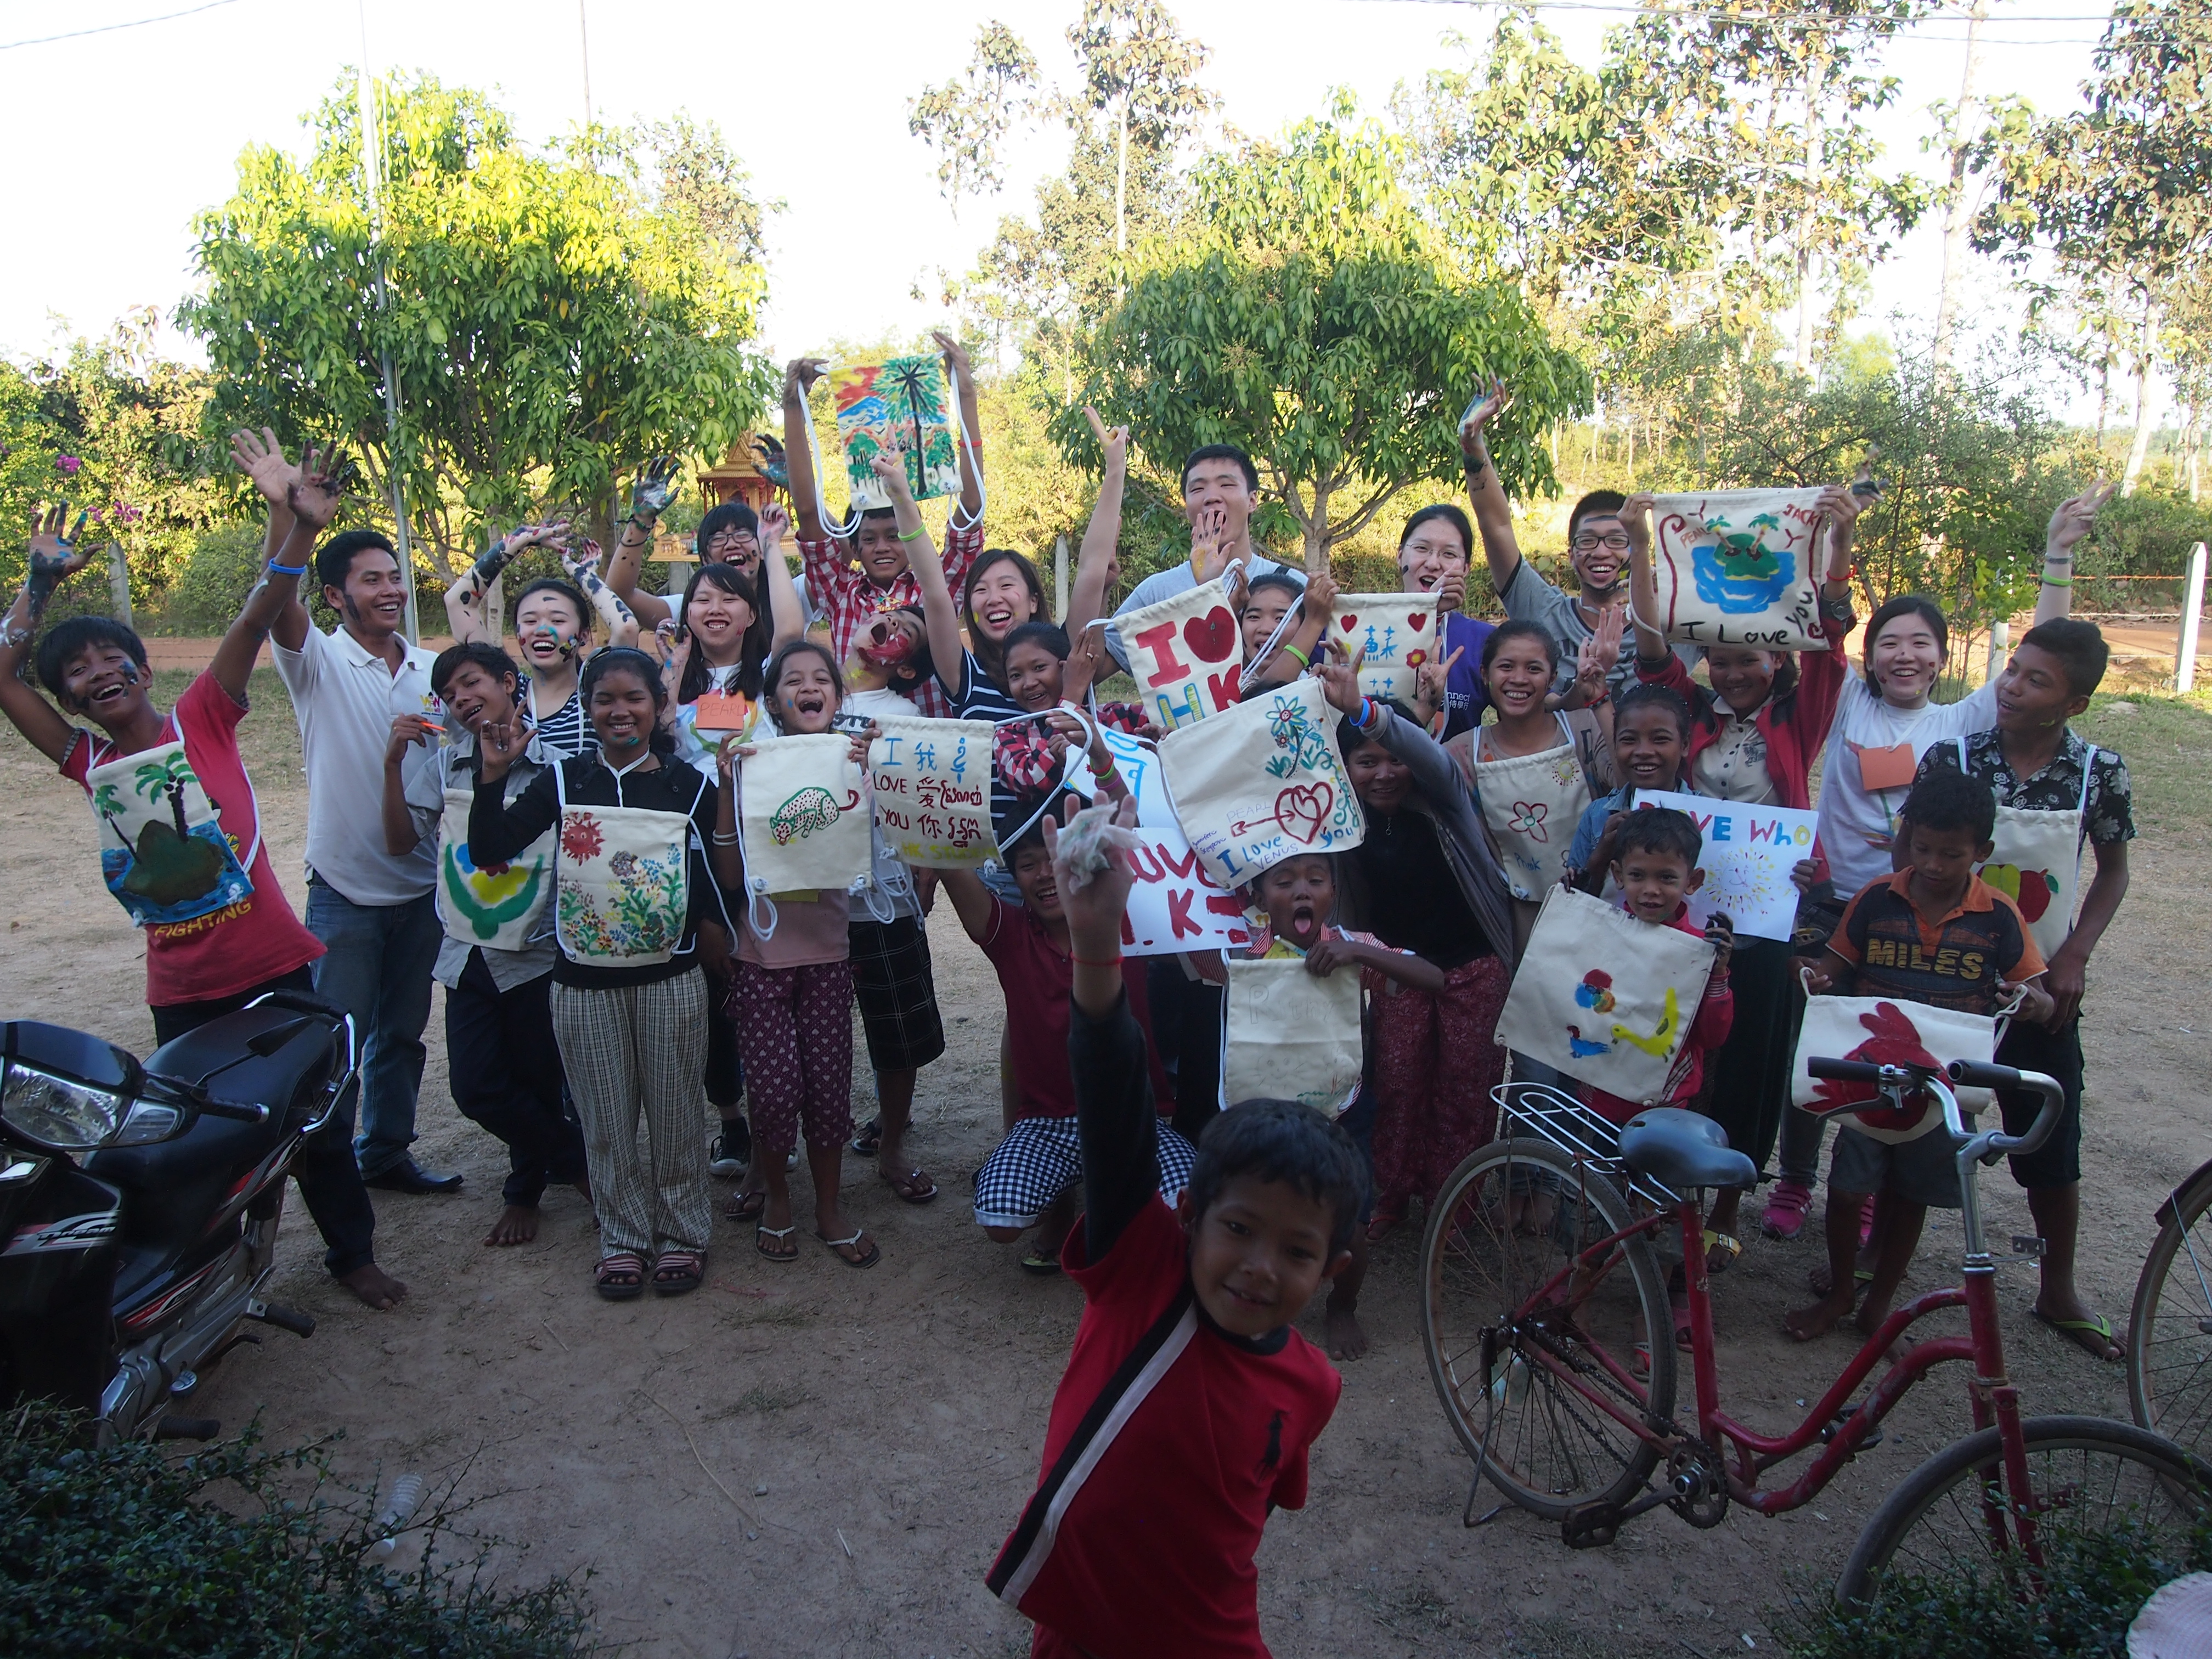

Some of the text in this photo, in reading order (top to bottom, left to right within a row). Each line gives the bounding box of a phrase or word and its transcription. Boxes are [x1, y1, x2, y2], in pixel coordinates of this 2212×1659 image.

[1680, 621, 1706, 641] I
[1718, 624, 1790, 645] Love
[1135, 621, 1191, 688] I
[700, 702, 744, 716] PEARL
[1156, 663, 1241, 729] HK
[881, 738, 904, 765] I
[914, 742, 937, 772] 我
[873, 770, 907, 794] LOVE
[880, 805, 910, 830] YOU
[1226, 801, 1271, 823] PEARL
[917, 814, 943, 839] 你
[1216, 848, 1244, 878] I
[1241, 836, 1283, 863] Love
[1252, 843, 1299, 870] VENUS
[154, 898, 251, 939] FIGHTING
[1866, 938, 1984, 980] MILES
